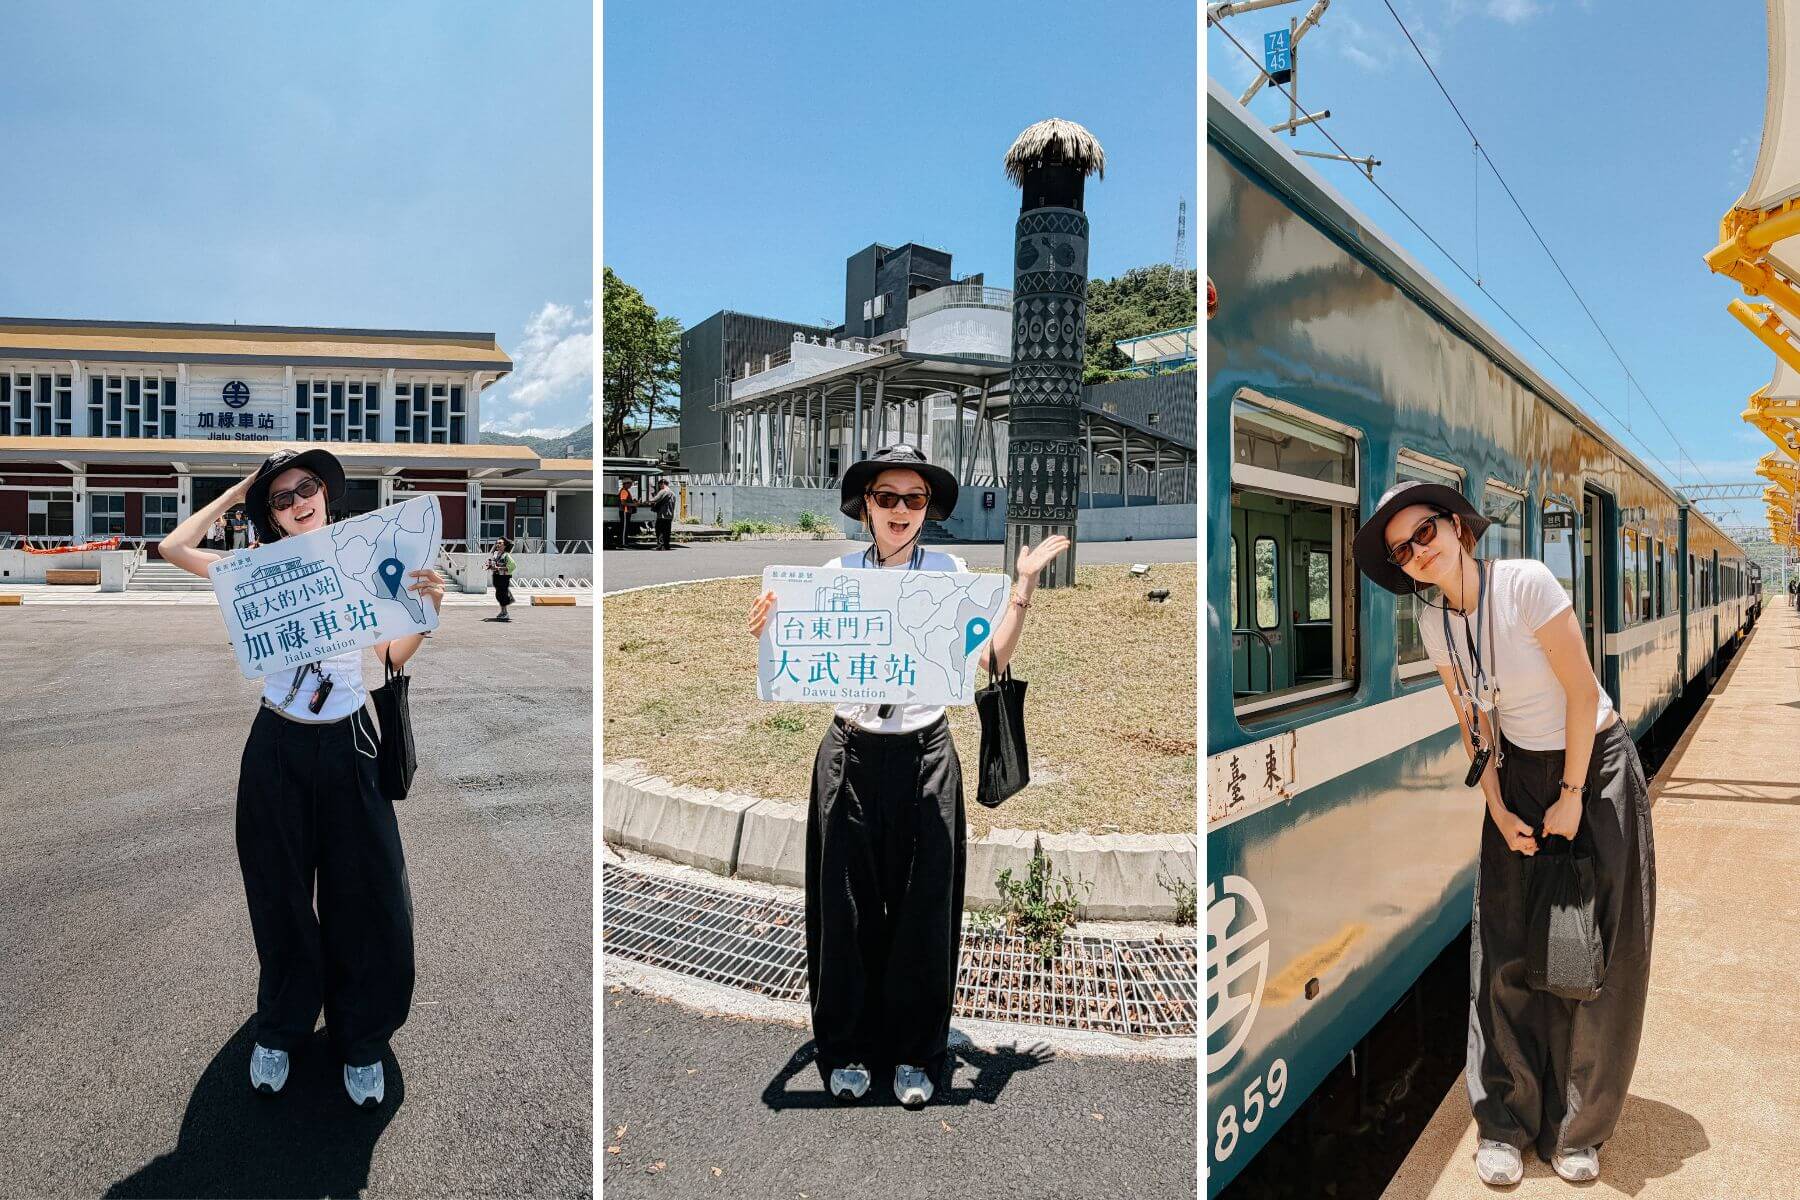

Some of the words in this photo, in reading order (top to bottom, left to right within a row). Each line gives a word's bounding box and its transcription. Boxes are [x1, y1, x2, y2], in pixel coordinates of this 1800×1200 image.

[1269, 32, 1284, 49] 74
[1270, 53, 1285, 70] 45
[198, 411, 275, 430] 加祿車站
[208, 432, 231, 441] Jialu
[235, 432, 269, 441] Station
[241, 575, 336, 622] 最大的小站
[242, 600, 378, 663] 加祿車站
[783, 616, 884, 641] 台東門戶
[285, 650, 312, 666] Jialu
[314, 638, 356, 656] Station
[768, 649, 916, 686] 大武車站
[802, 686, 837, 698] Dawu
[841, 686, 886, 699] Station
[1227, 743, 1282, 808] 臺東
[1207, 1058, 1288, 1179] 859
